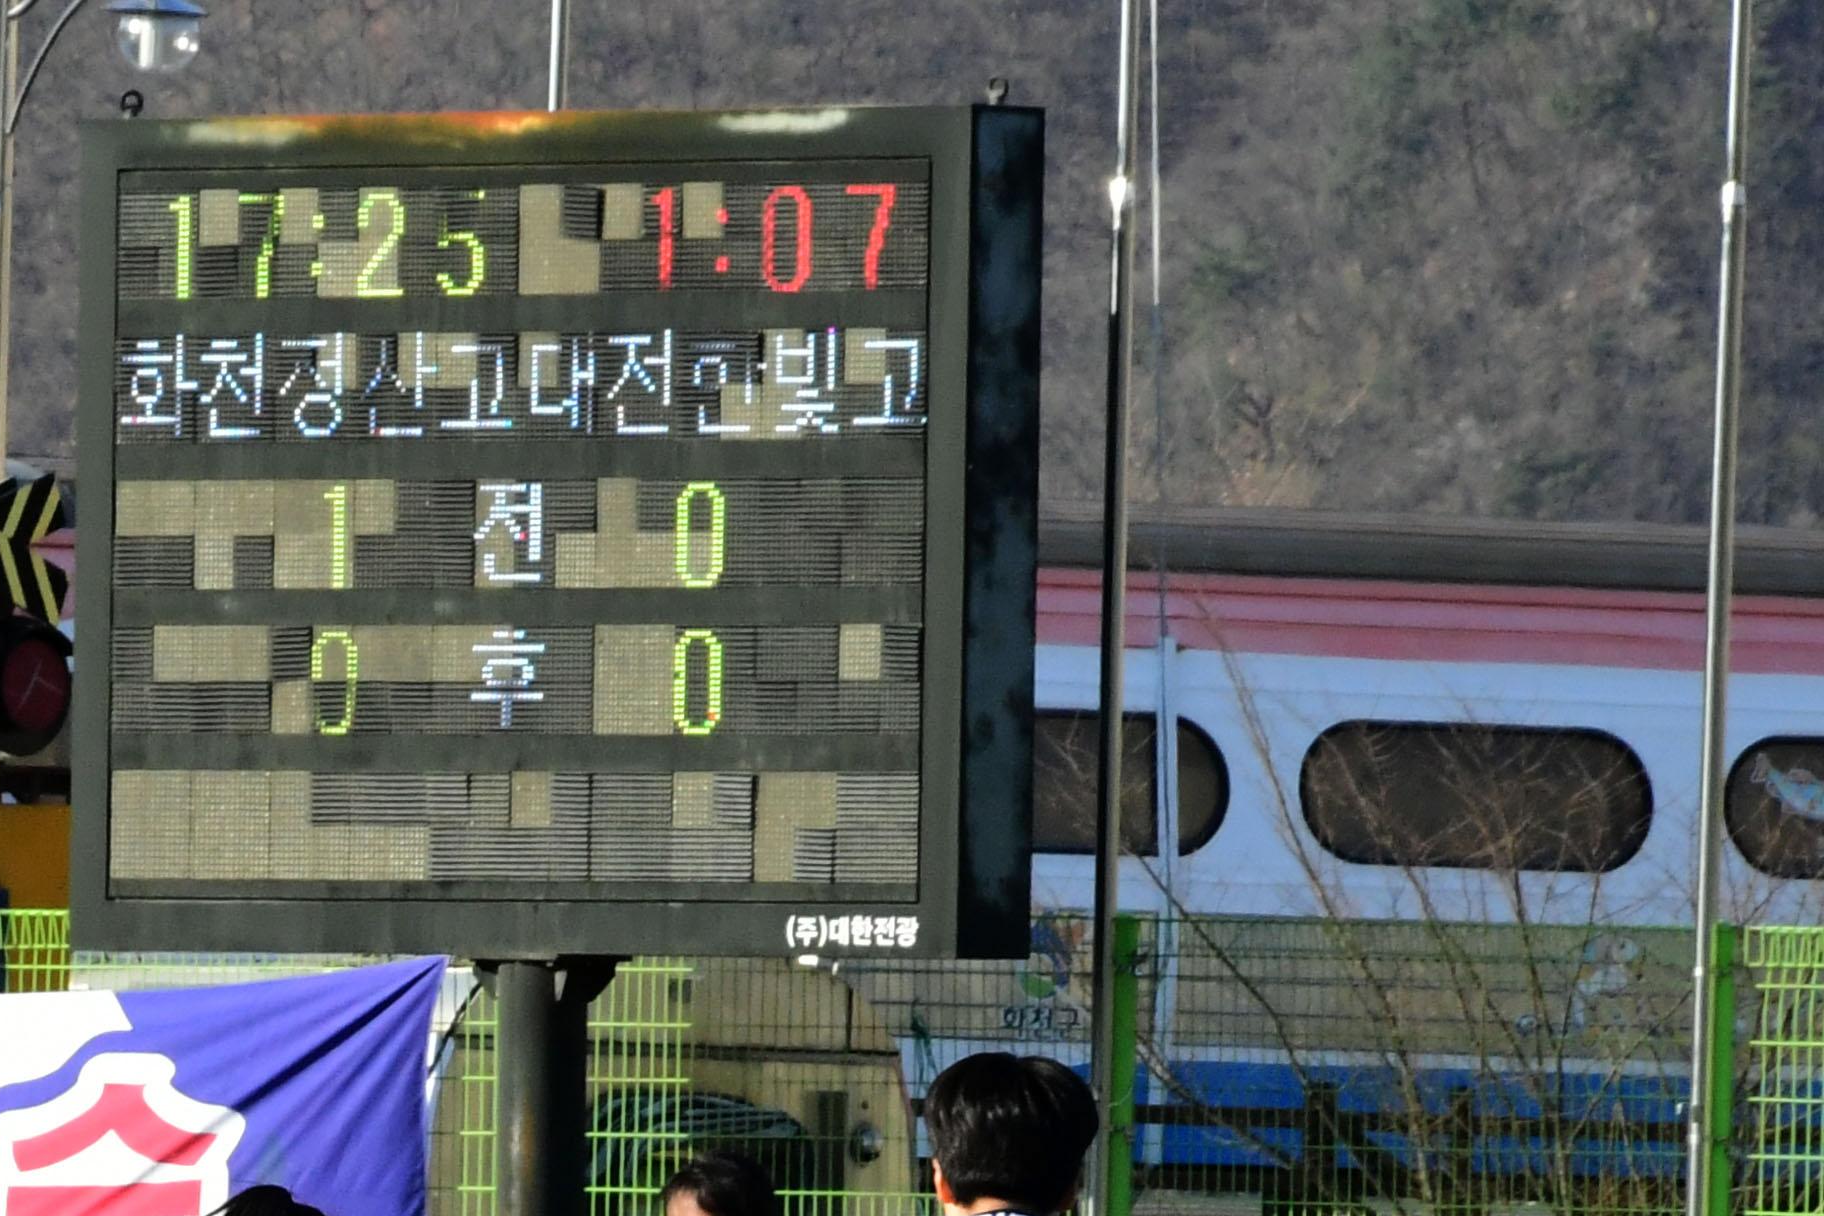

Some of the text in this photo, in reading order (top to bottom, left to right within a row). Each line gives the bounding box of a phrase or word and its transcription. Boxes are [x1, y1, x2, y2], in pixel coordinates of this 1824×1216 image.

[169, 184, 897, 299] 17:25 1:07
[324, 481, 725, 588] 1 전 0
[470, 628, 547, 730] 후
[672, 629, 723, 735] 0
[785, 914, 921, 948] (주)대한전광
